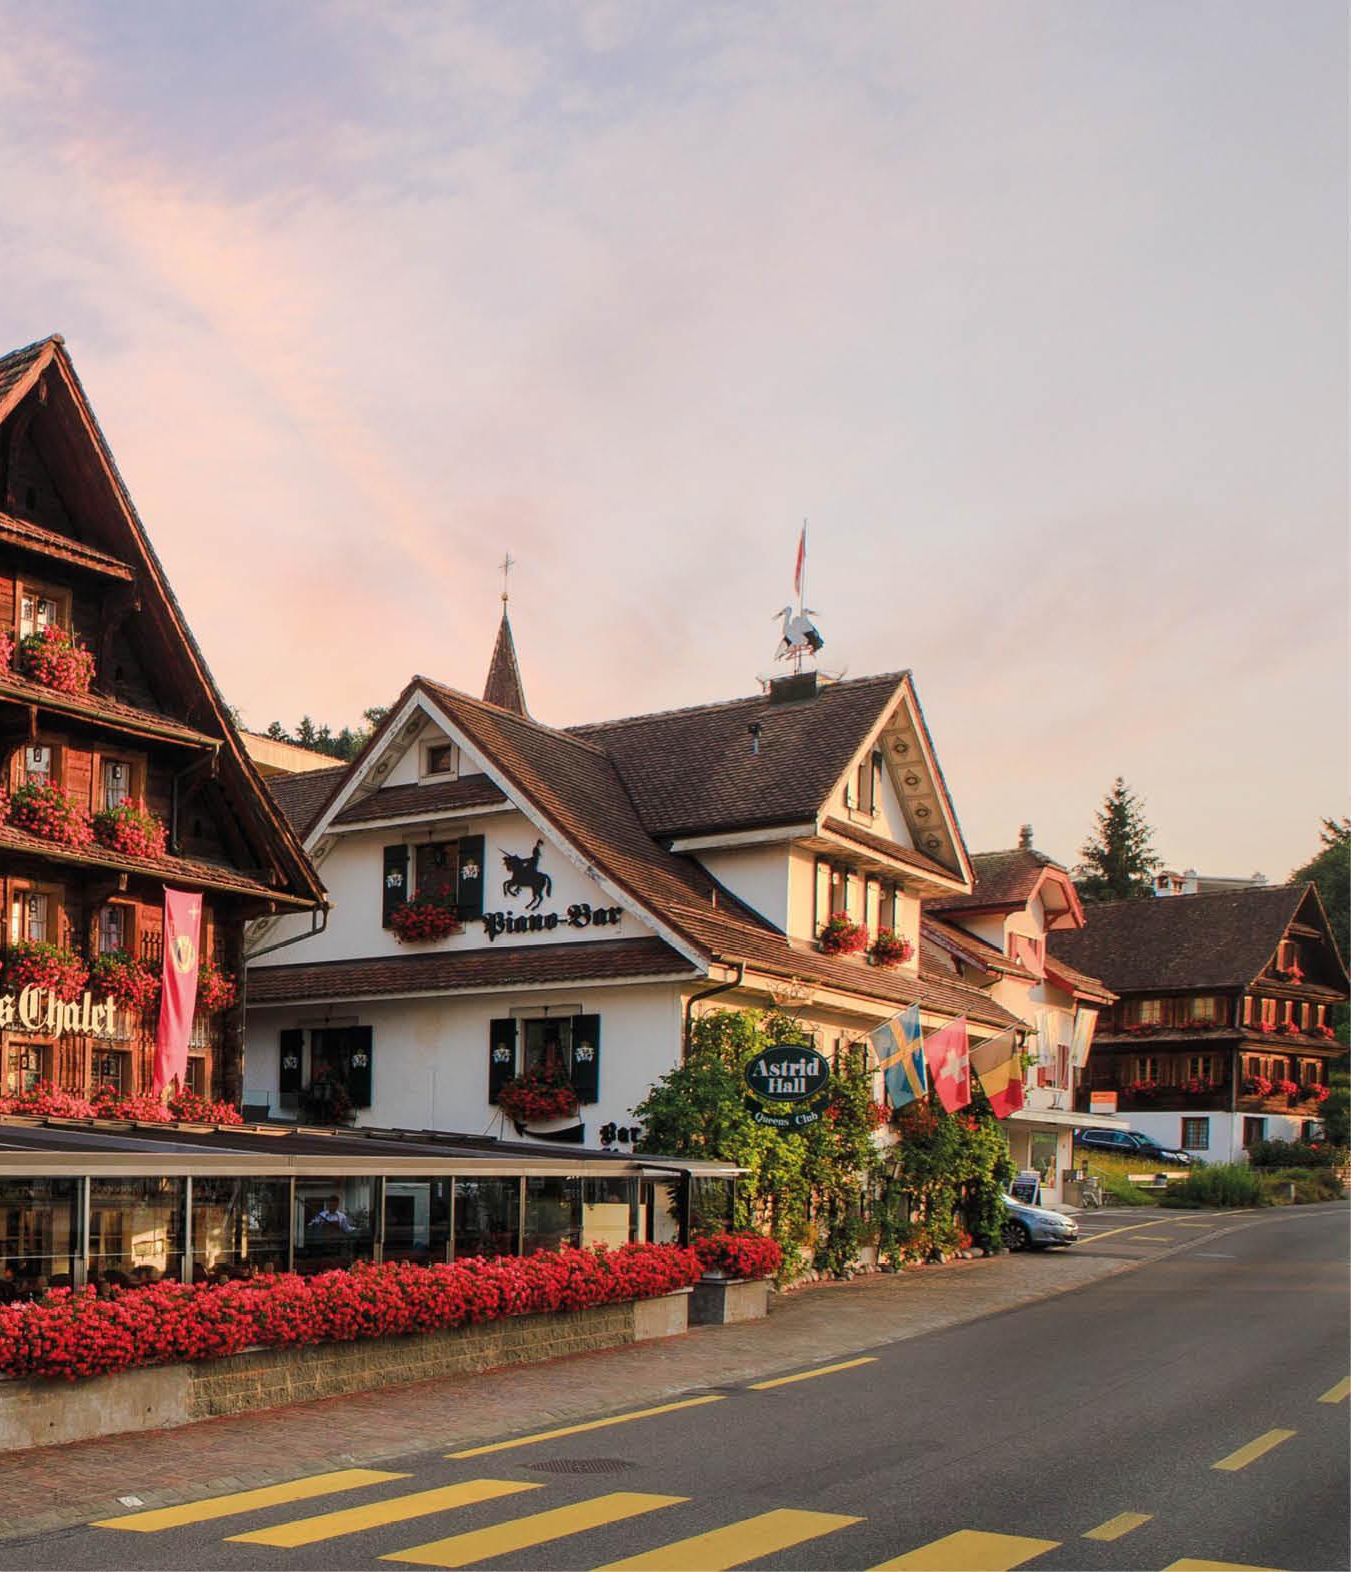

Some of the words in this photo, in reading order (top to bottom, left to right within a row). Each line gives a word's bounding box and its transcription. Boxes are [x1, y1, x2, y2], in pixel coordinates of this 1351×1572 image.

[482, 903, 624, 942] Piano-Bar
[19, 983, 118, 1040] Chalet
[752, 1057, 819, 1077] Astrid
[768, 1077, 806, 1093] Hall
[754, 1111, 790, 1126] Queens
[795, 1111, 819, 1125] Club
[599, 1122, 642, 1146] Bar
